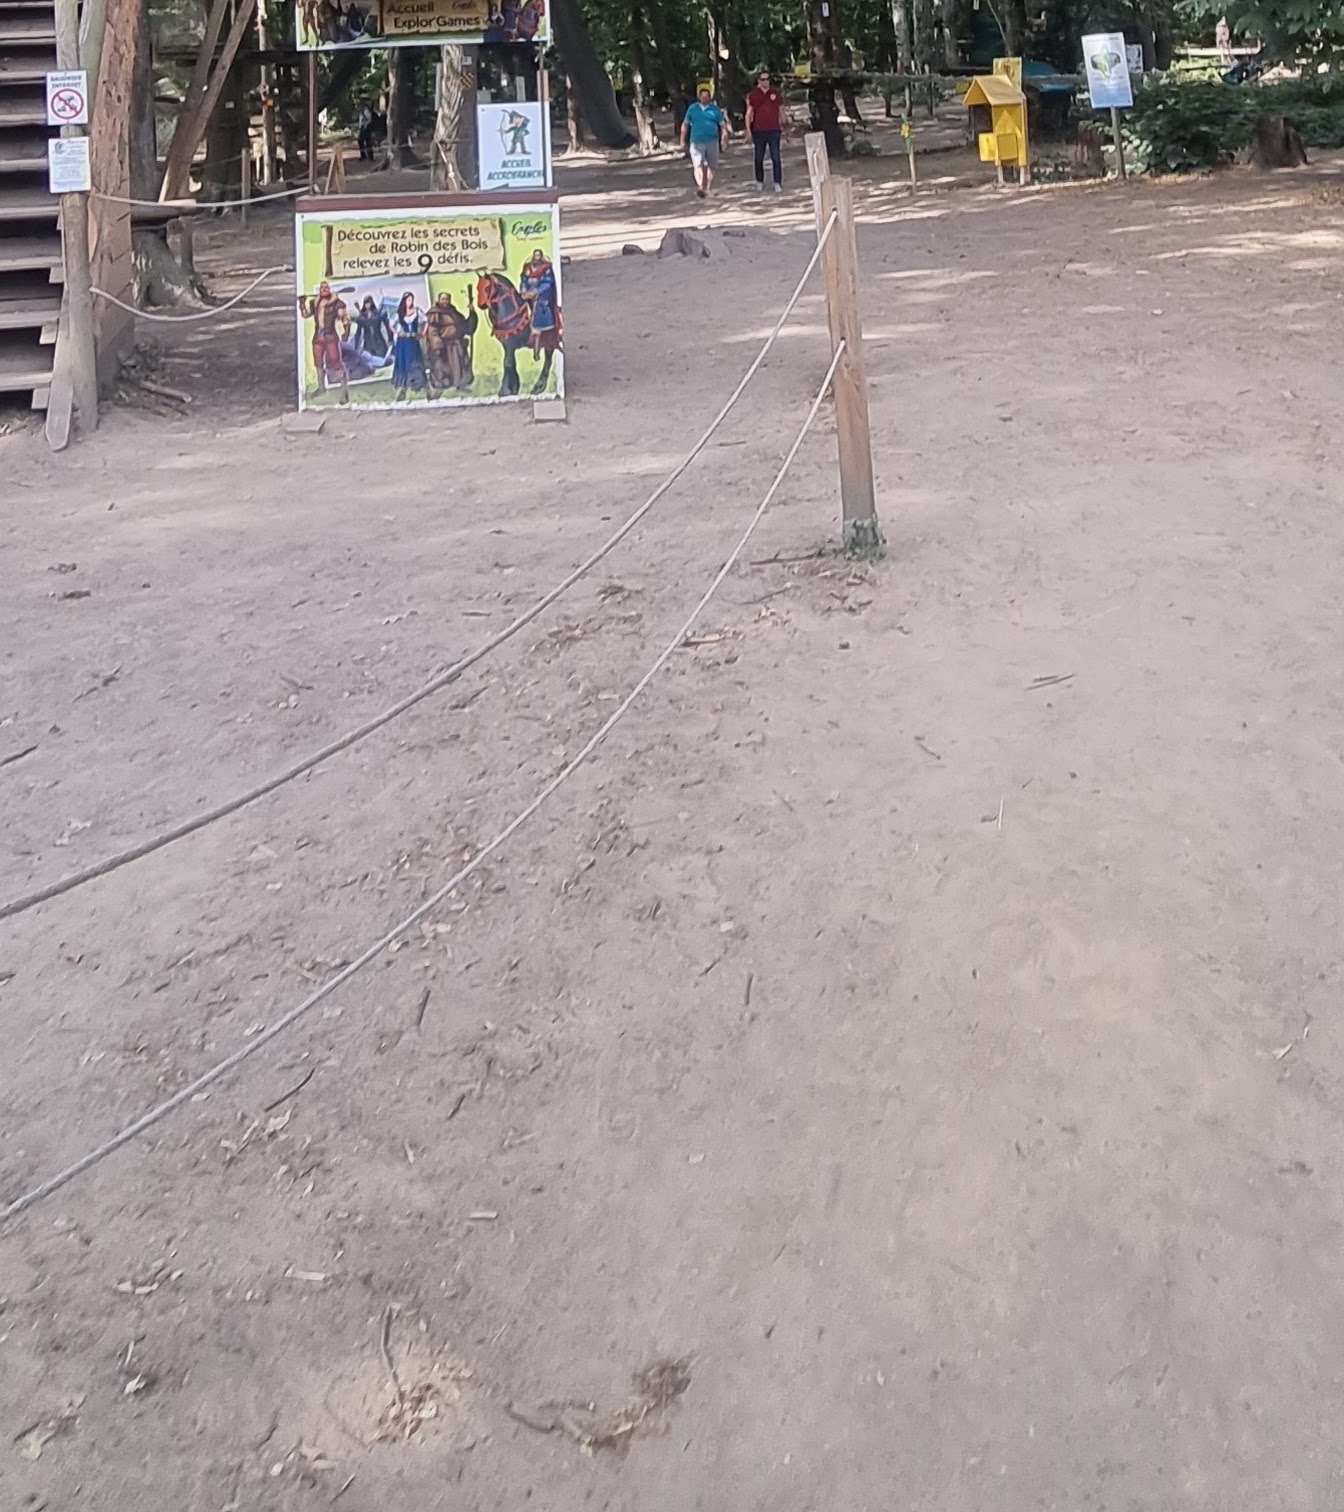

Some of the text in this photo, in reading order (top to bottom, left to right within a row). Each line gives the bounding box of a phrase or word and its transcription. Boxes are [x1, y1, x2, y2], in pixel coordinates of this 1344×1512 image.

[387, 1, 435, 13] Accueil
[501, 159, 532, 169] ACCUEIL
[337, 226, 480, 242] Découvrez les secrets
[369, 238, 488, 254] de Robin des Bois
[343, 252, 474, 274] relevez les 9 défis.
